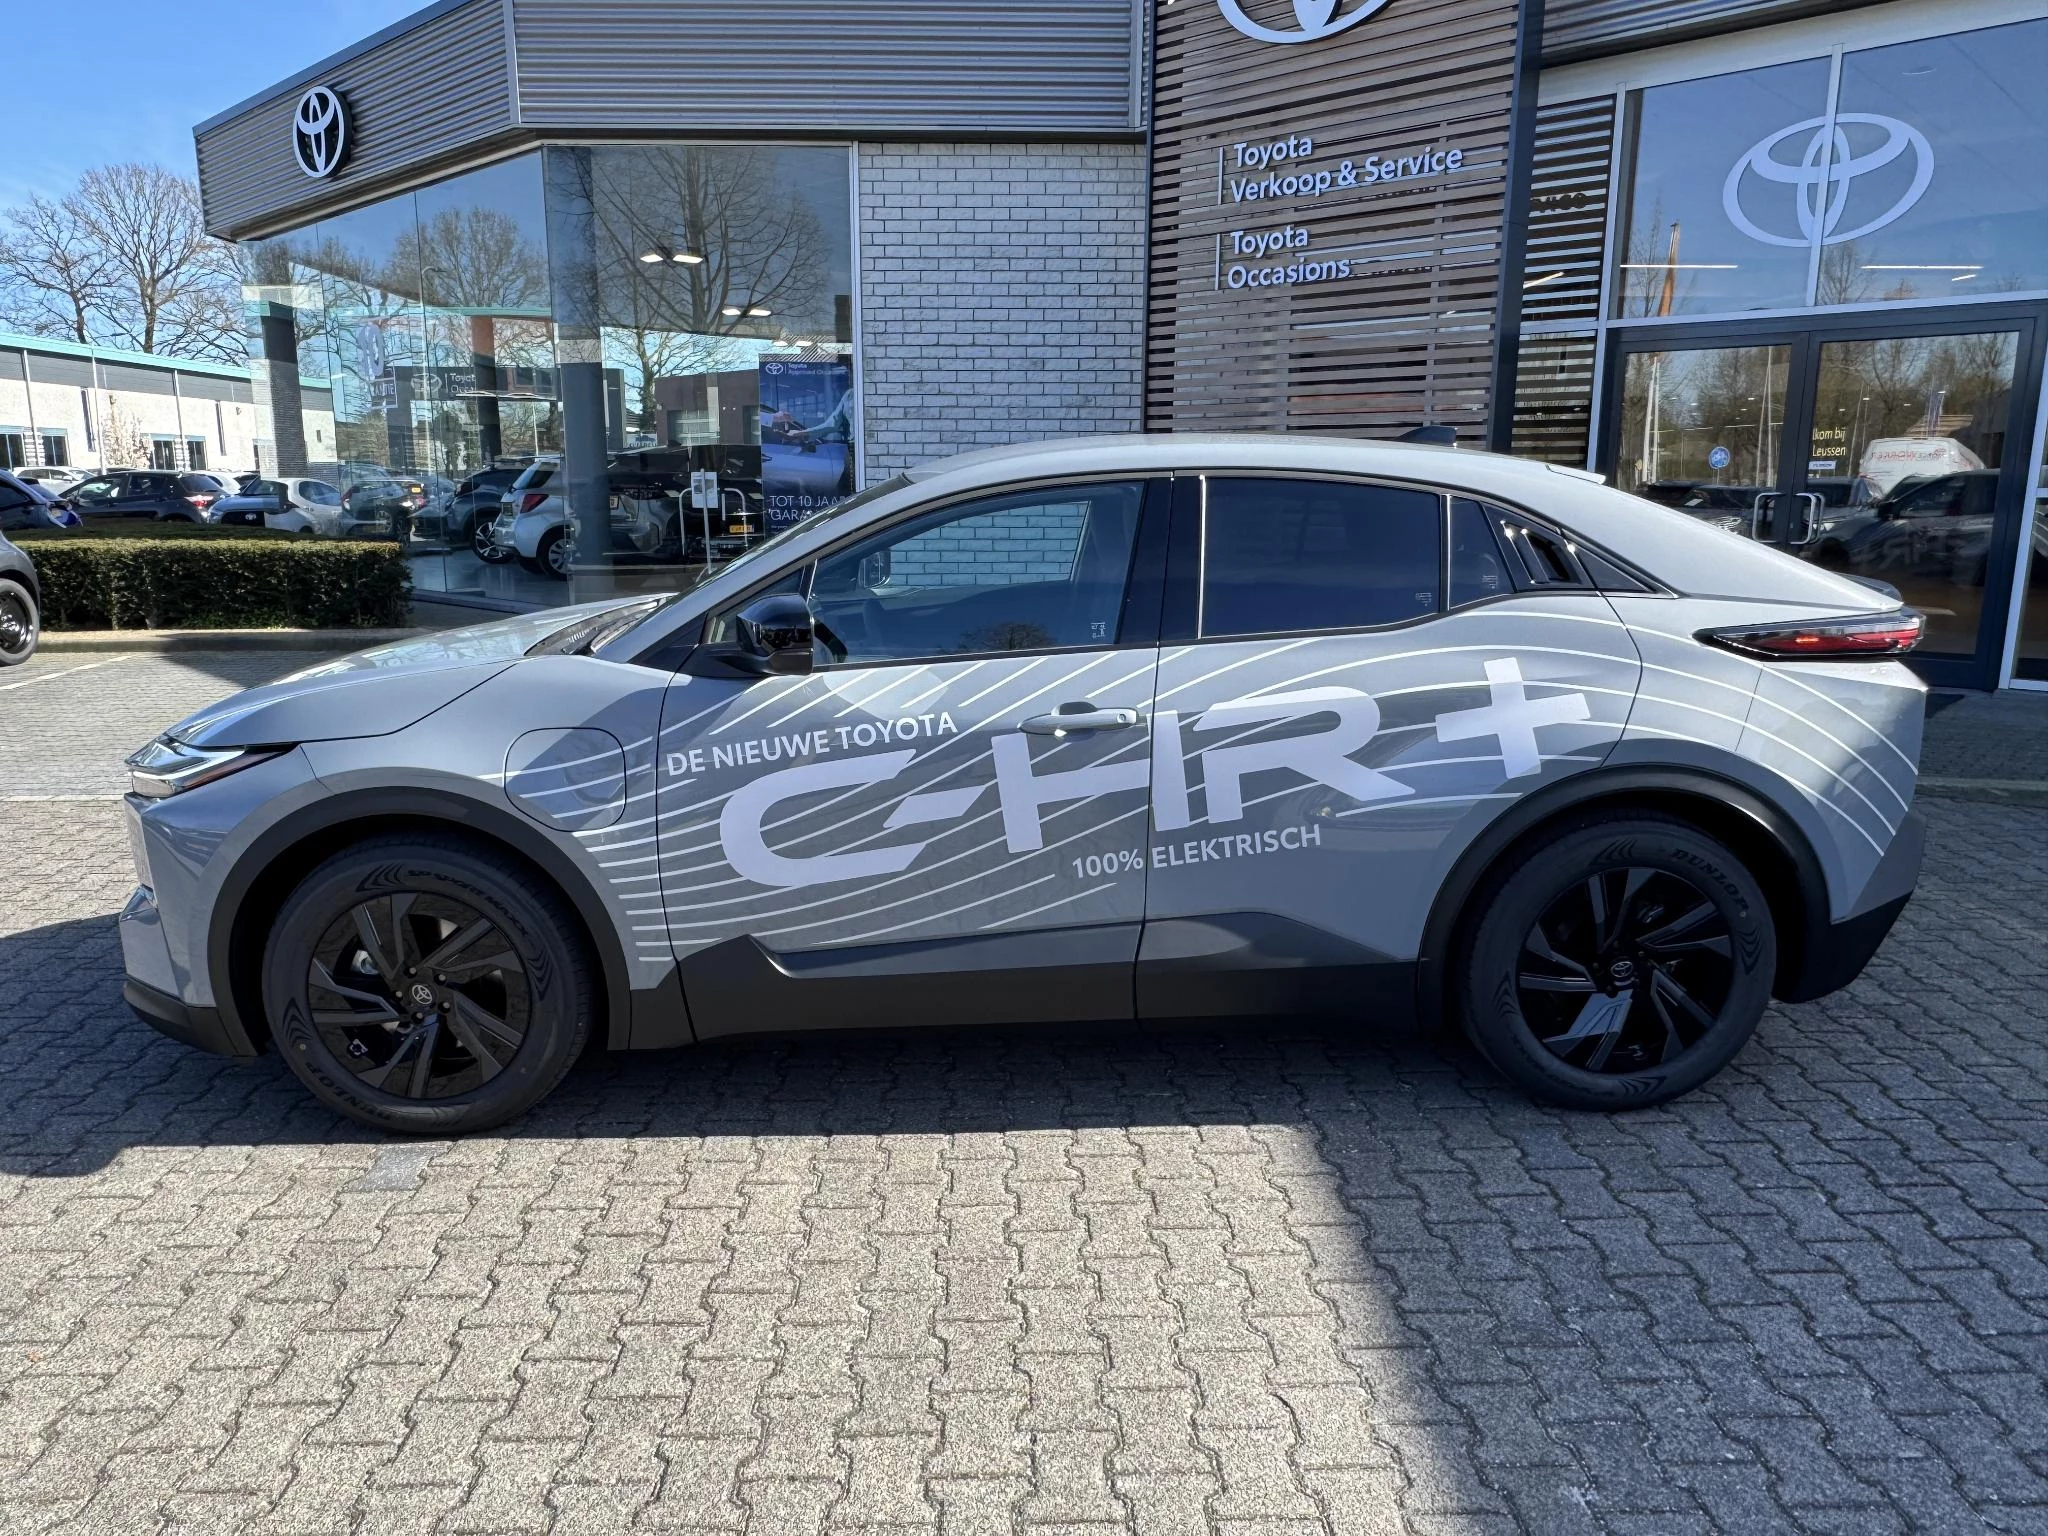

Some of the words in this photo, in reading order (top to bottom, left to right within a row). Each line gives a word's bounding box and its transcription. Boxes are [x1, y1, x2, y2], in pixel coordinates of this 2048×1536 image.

[1233, 134, 1313, 171] Toyota
[1230, 169, 1332, 203] Verkoop
[1337, 160, 1357, 186] &
[1364, 146, 1463, 183] Service
[1230, 224, 1309, 259] Toyota
[1227, 256, 1351, 289] Occasions
[1812, 445, 1846, 457] Leussen
[769, 495, 795, 507] TOT
[799, 495, 812, 507] 10
[666, 748, 706, 776] DE
[713, 730, 830, 769] NIEUWE
[834, 711, 958, 750] TOYOTA
[1072, 849, 1144, 879] 100%
[1152, 823, 1321, 869] ELEKTRISCH
[1670, 848, 1750, 911] DUNLOP
